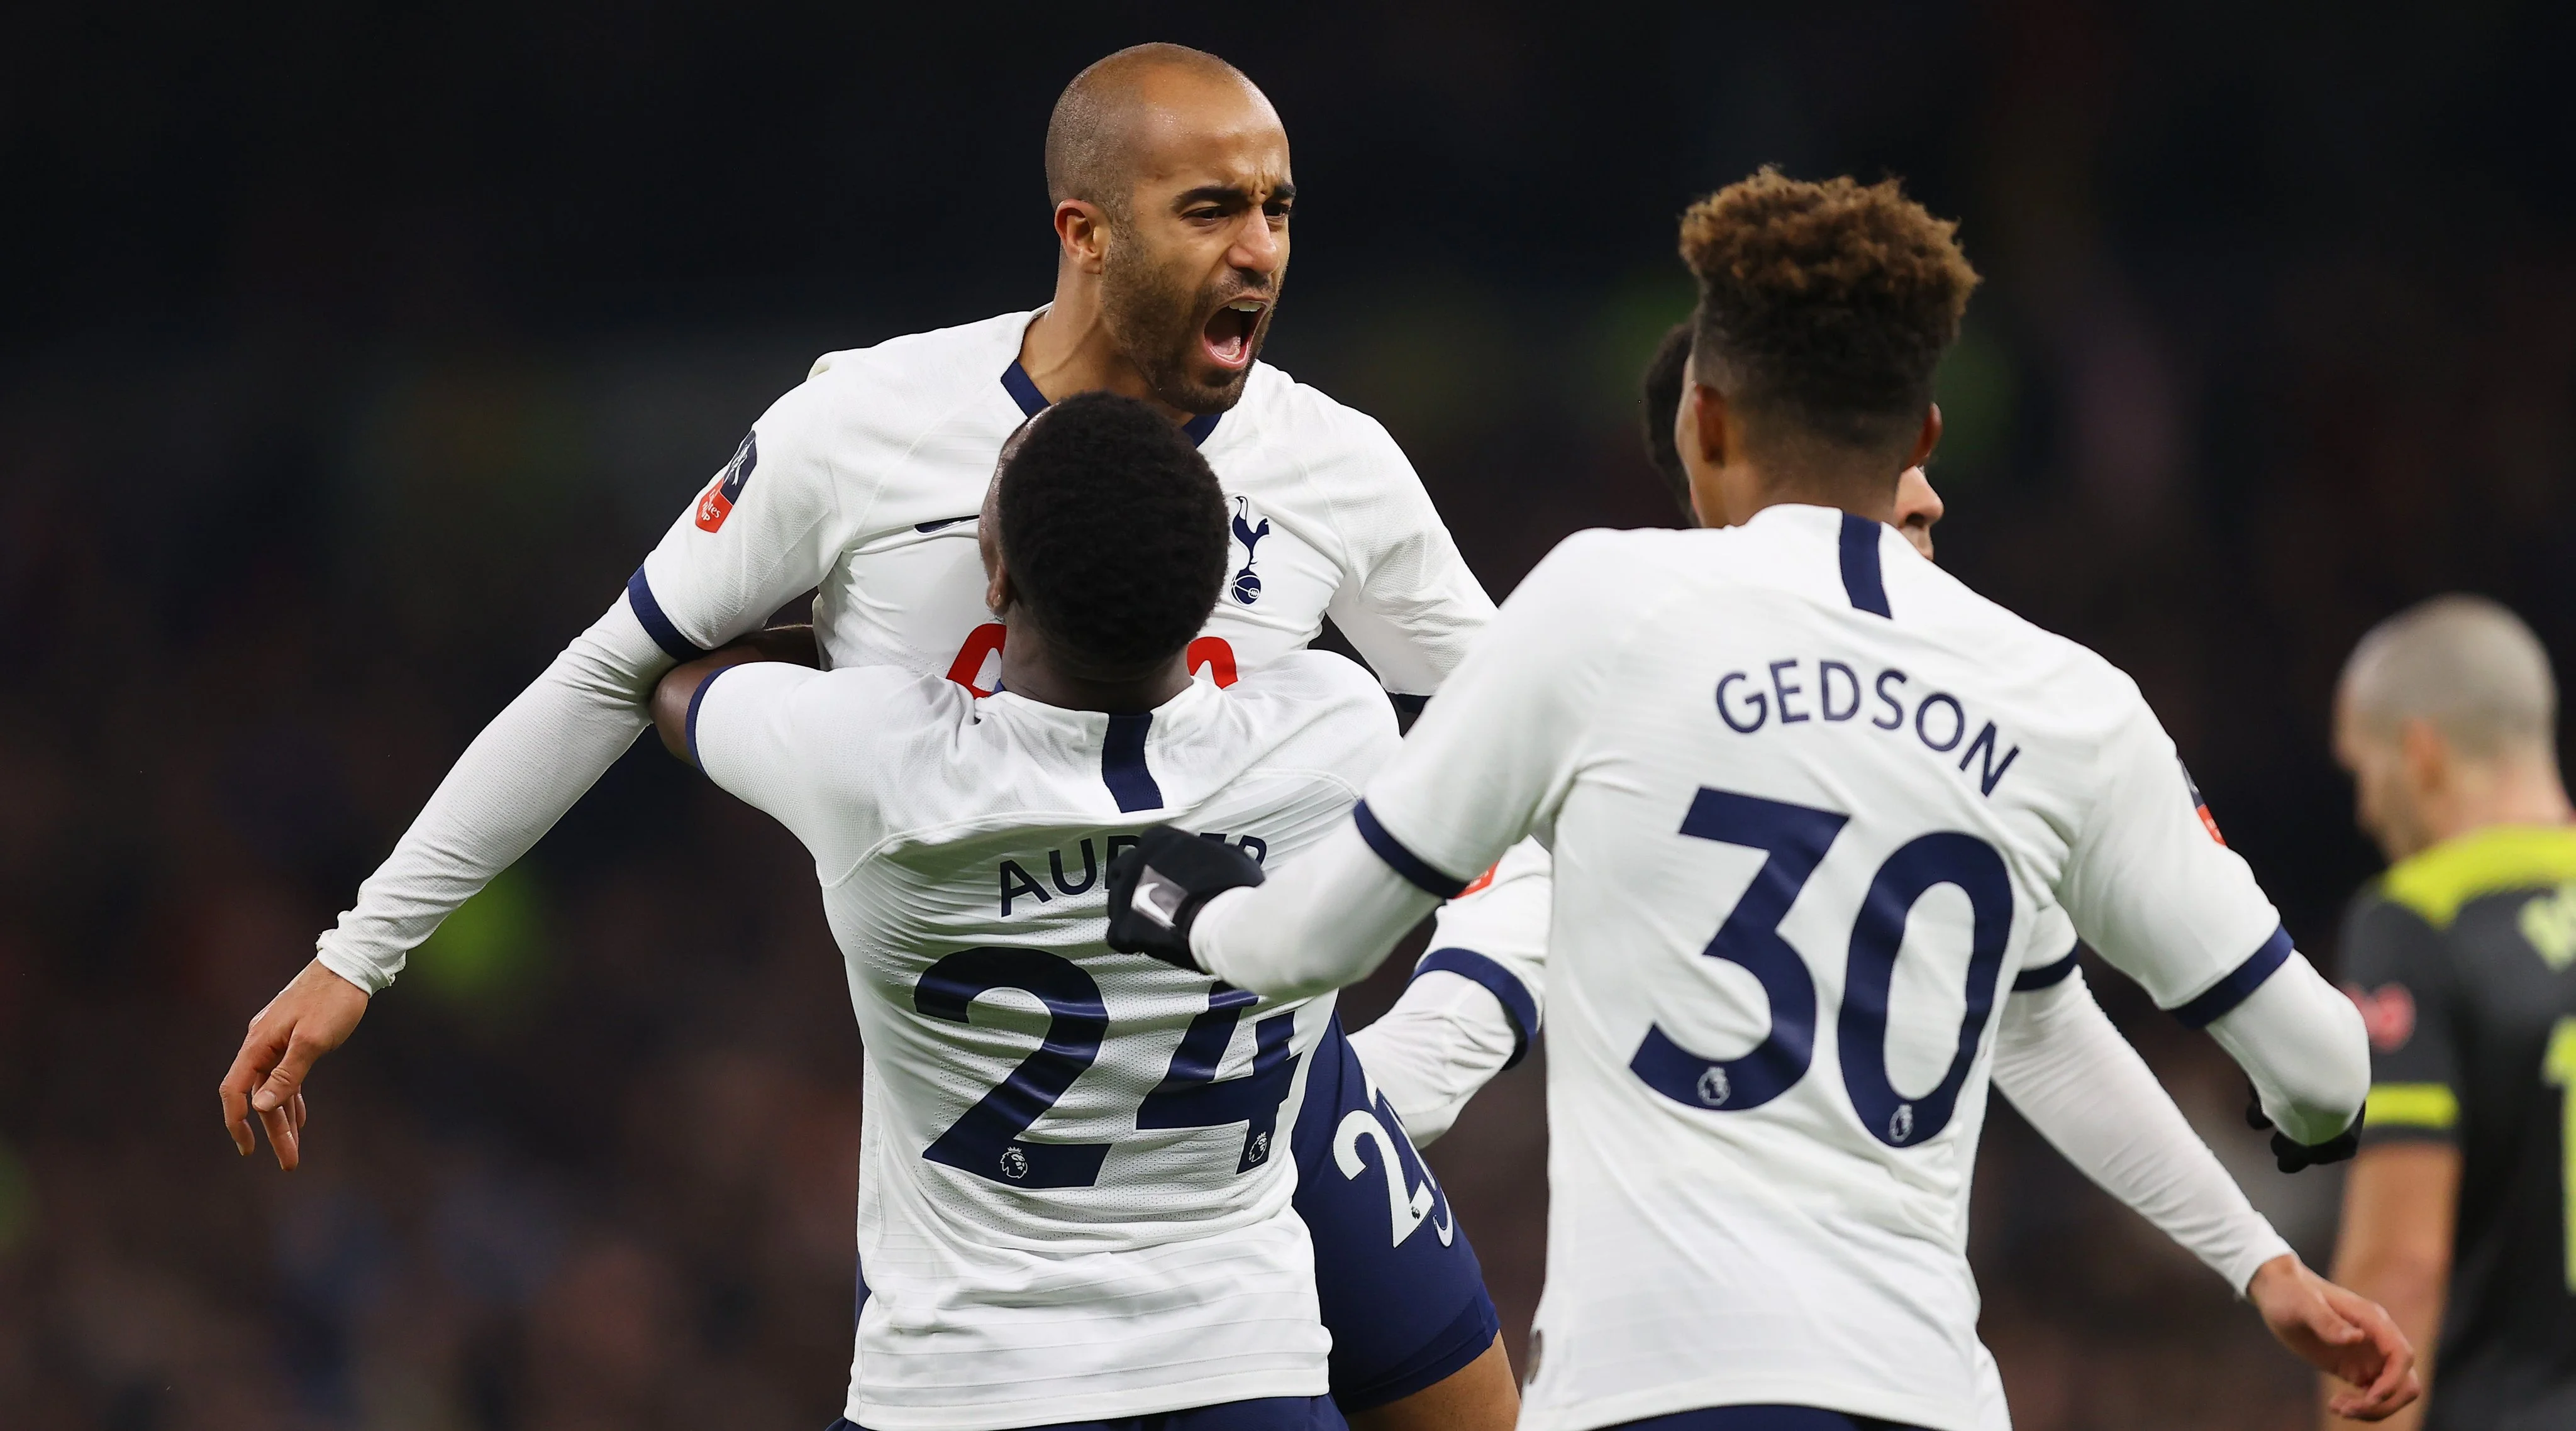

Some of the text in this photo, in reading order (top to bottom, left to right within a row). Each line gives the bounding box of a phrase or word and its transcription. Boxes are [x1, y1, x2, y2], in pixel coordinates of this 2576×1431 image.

[1716, 658, 2020, 797] GEDSON
[914, 946, 1304, 1189] 24
[1628, 785, 2013, 1148] 30
